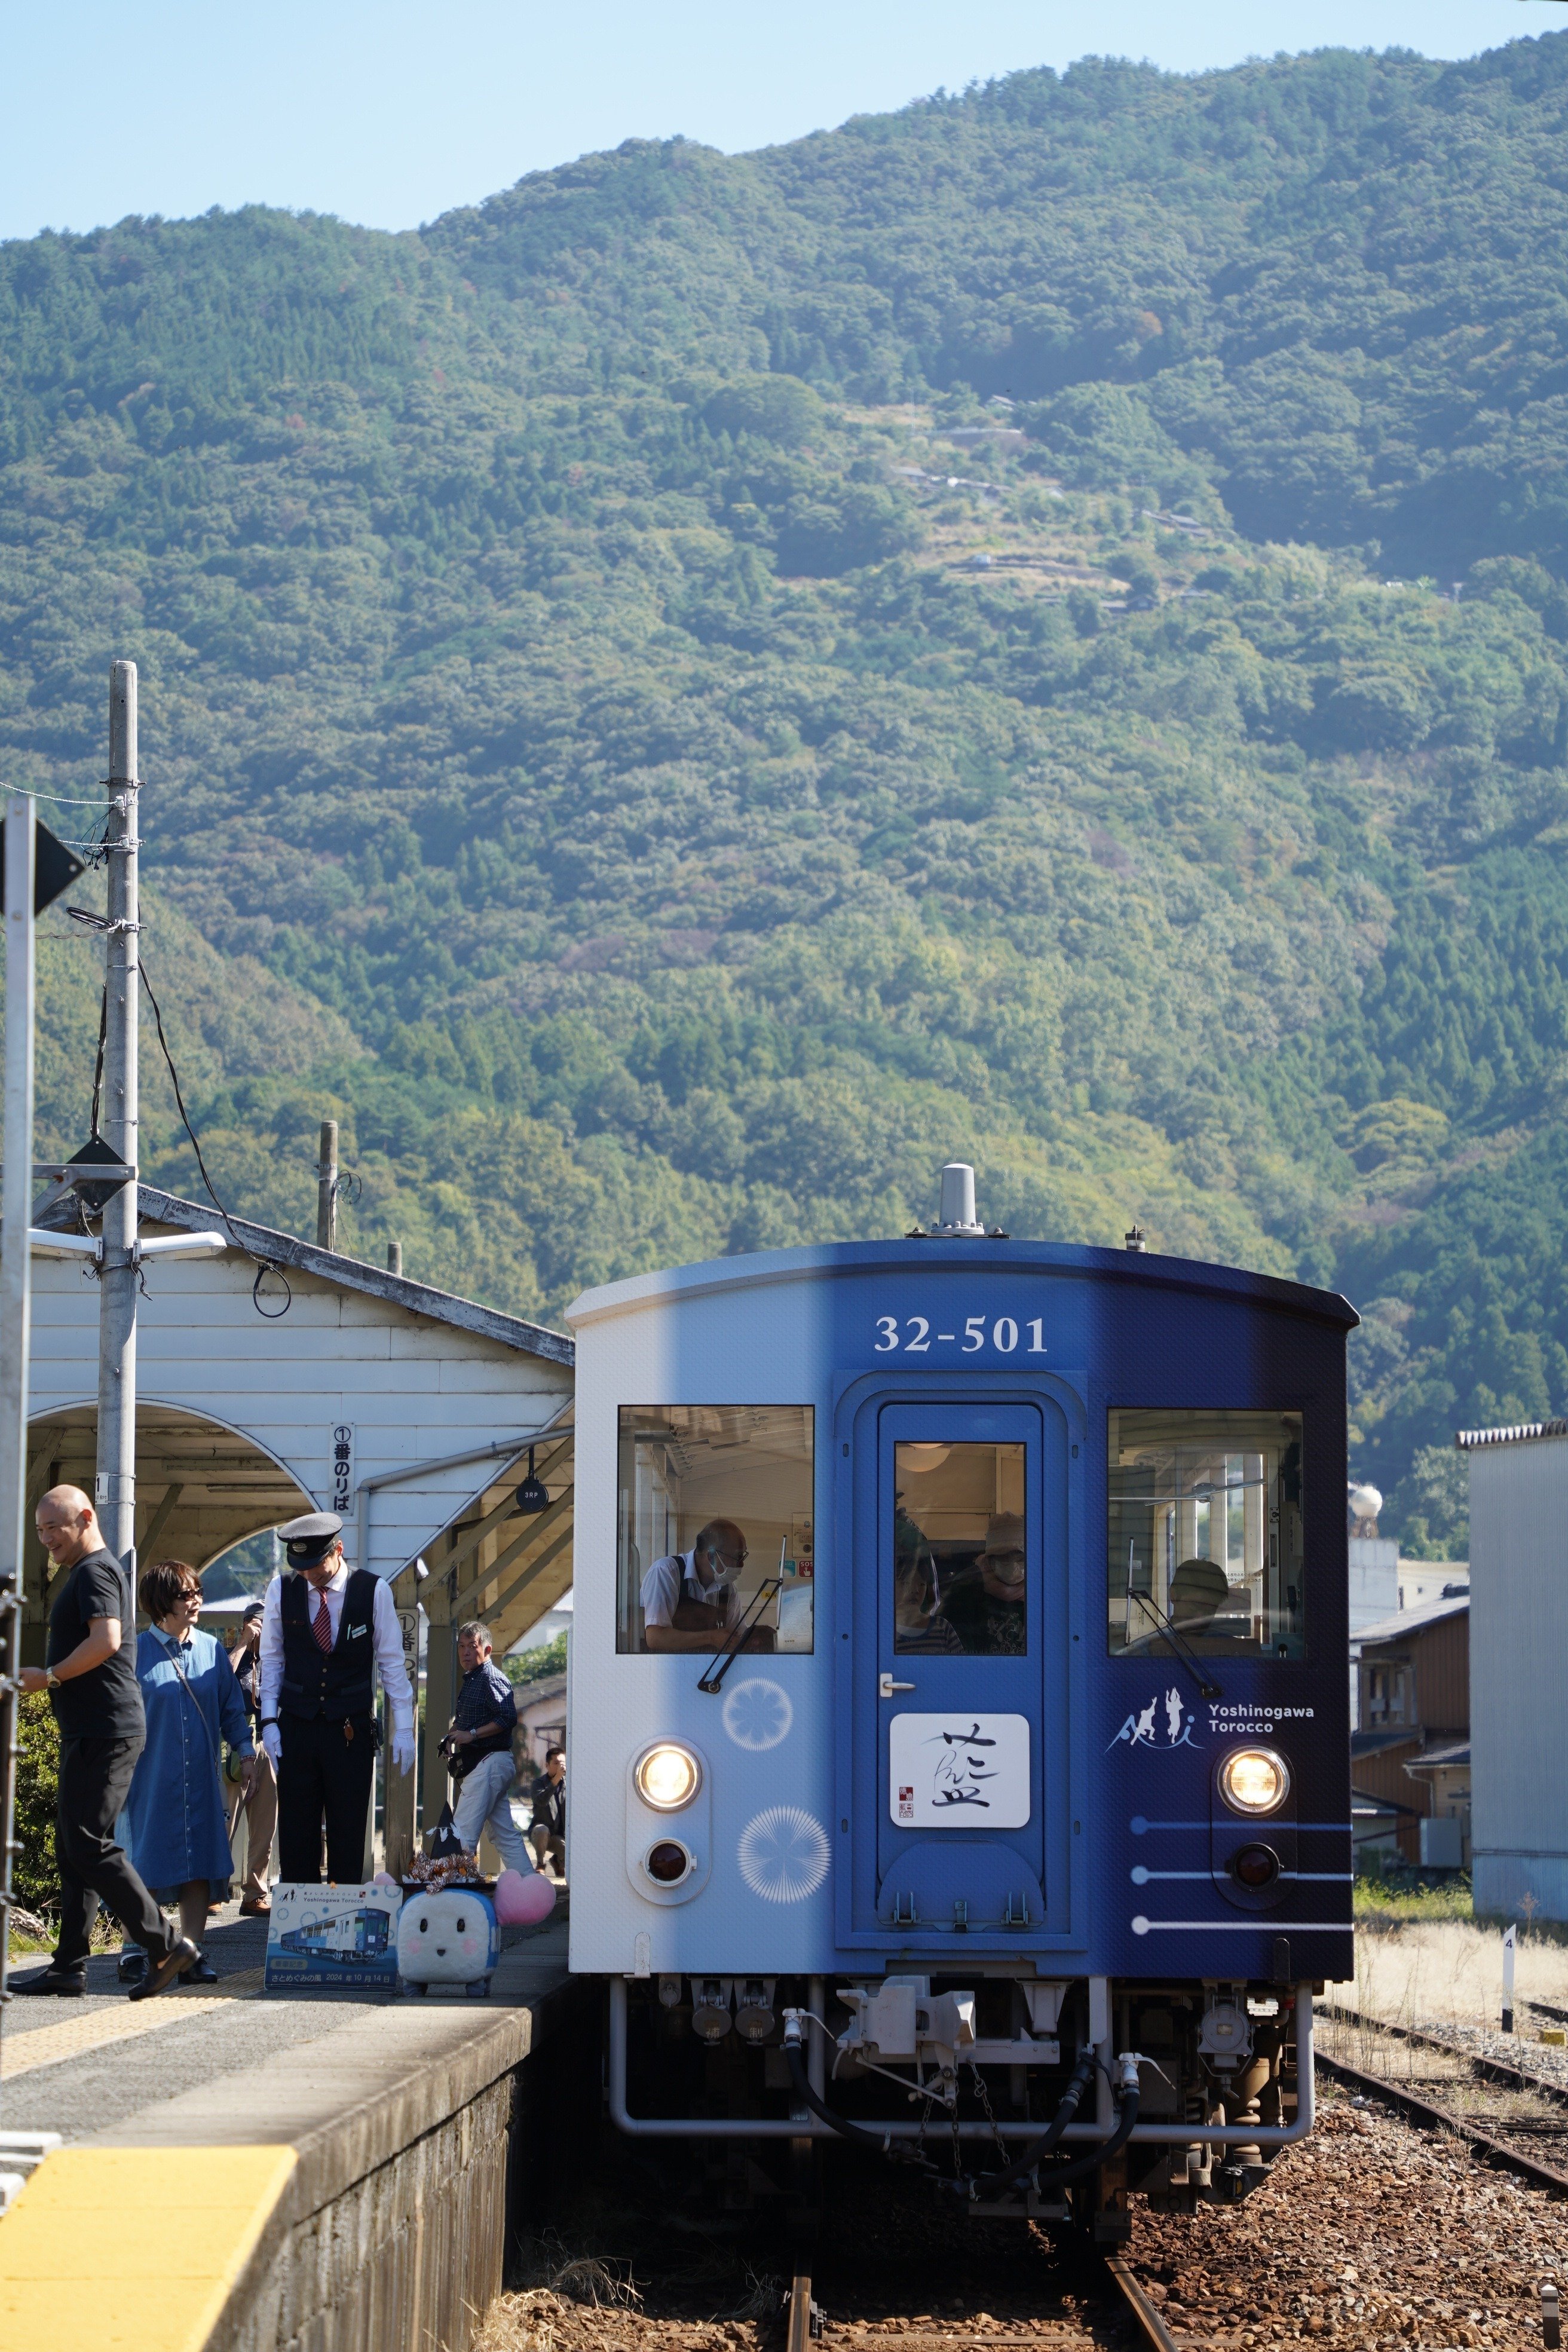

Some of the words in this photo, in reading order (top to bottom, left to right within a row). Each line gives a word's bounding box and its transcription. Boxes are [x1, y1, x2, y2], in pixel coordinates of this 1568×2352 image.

[874, 1315, 1047, 1352] 32-501
[334, 1426, 351, 1511] ①番のりば
[1209, 1704, 1314, 1720] Yoshinogawa
[1209, 1720, 1273, 1732] Torocco
[1506, 1939, 1512, 1948] 4
